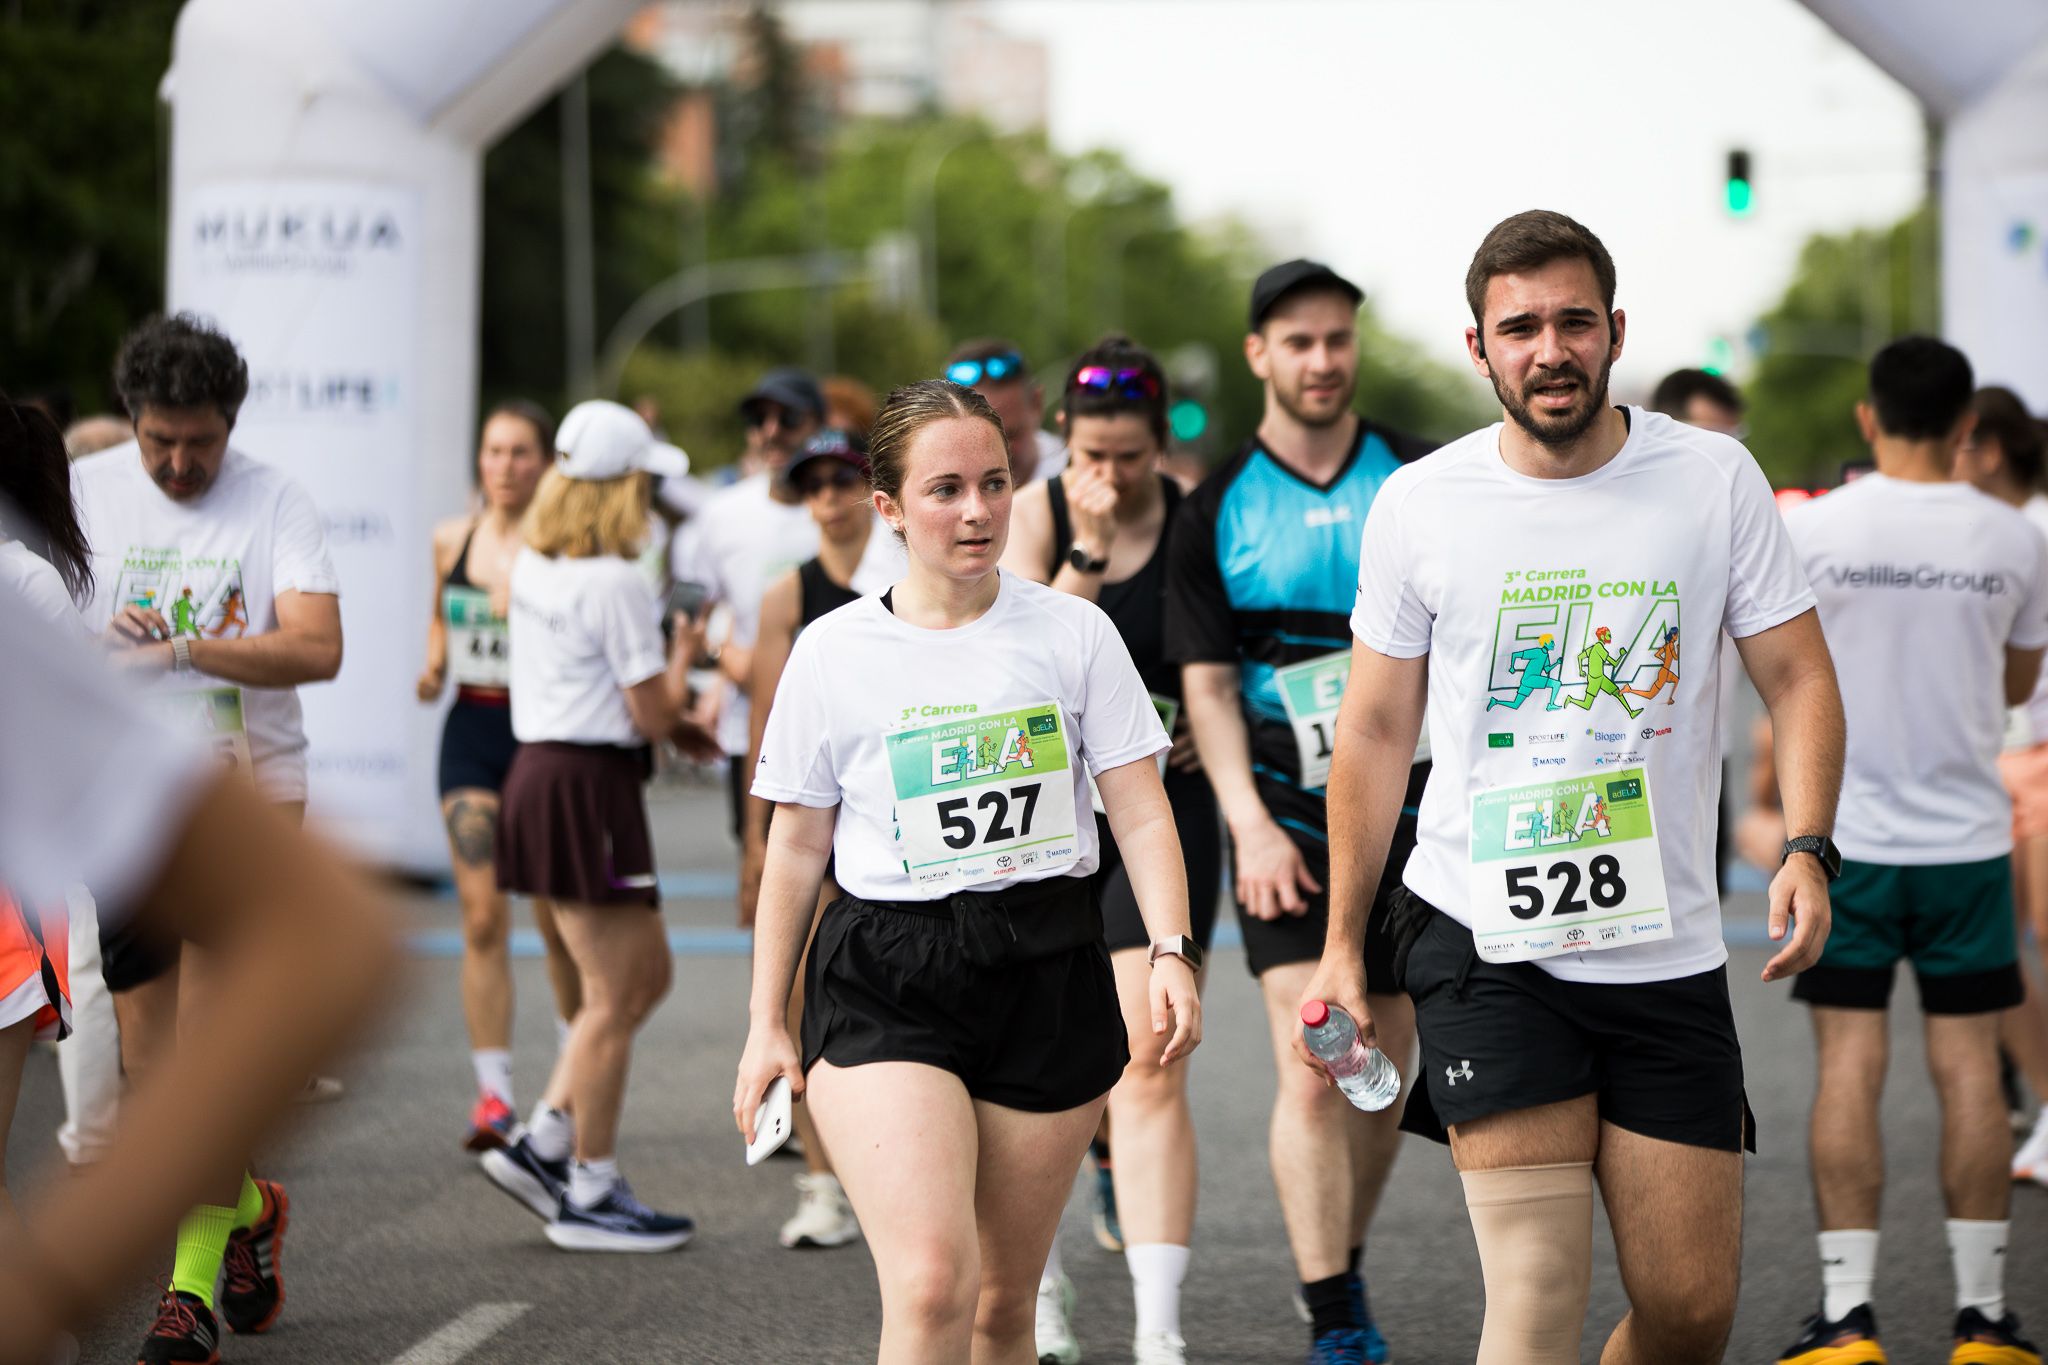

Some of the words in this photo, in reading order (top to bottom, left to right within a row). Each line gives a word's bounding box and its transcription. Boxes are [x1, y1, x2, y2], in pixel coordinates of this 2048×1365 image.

[1504, 571, 1521, 583] 3ª
[1525, 569, 1586, 582] Carrera
[1501, 583, 1592, 604] MADRID
[1597, 581, 1646, 598] CON
[1651, 580, 1679, 596] LA
[1488, 599, 1680, 692] ELA
[920, 704, 977, 717] Carrera
[931, 724, 976, 740] MADRID
[979, 719, 1001, 732] CON
[1003, 717, 1017, 727] LA
[1594, 731, 1626, 742] Biogen
[931, 726, 1034, 786] ELA
[1540, 757, 1566, 766] MADRID
[1509, 787, 1553, 801] MADRID
[1556, 785, 1579, 796] CON
[1582, 781, 1595, 792] LA
[937, 783, 1041, 850] 527
[1504, 792, 1611, 851] ELA
[1023, 857, 1034, 865] LIFE
[1052, 848, 1072, 857] MADRID
[1505, 854, 1627, 920] 528
[1601, 932, 1616, 940] LIFE
